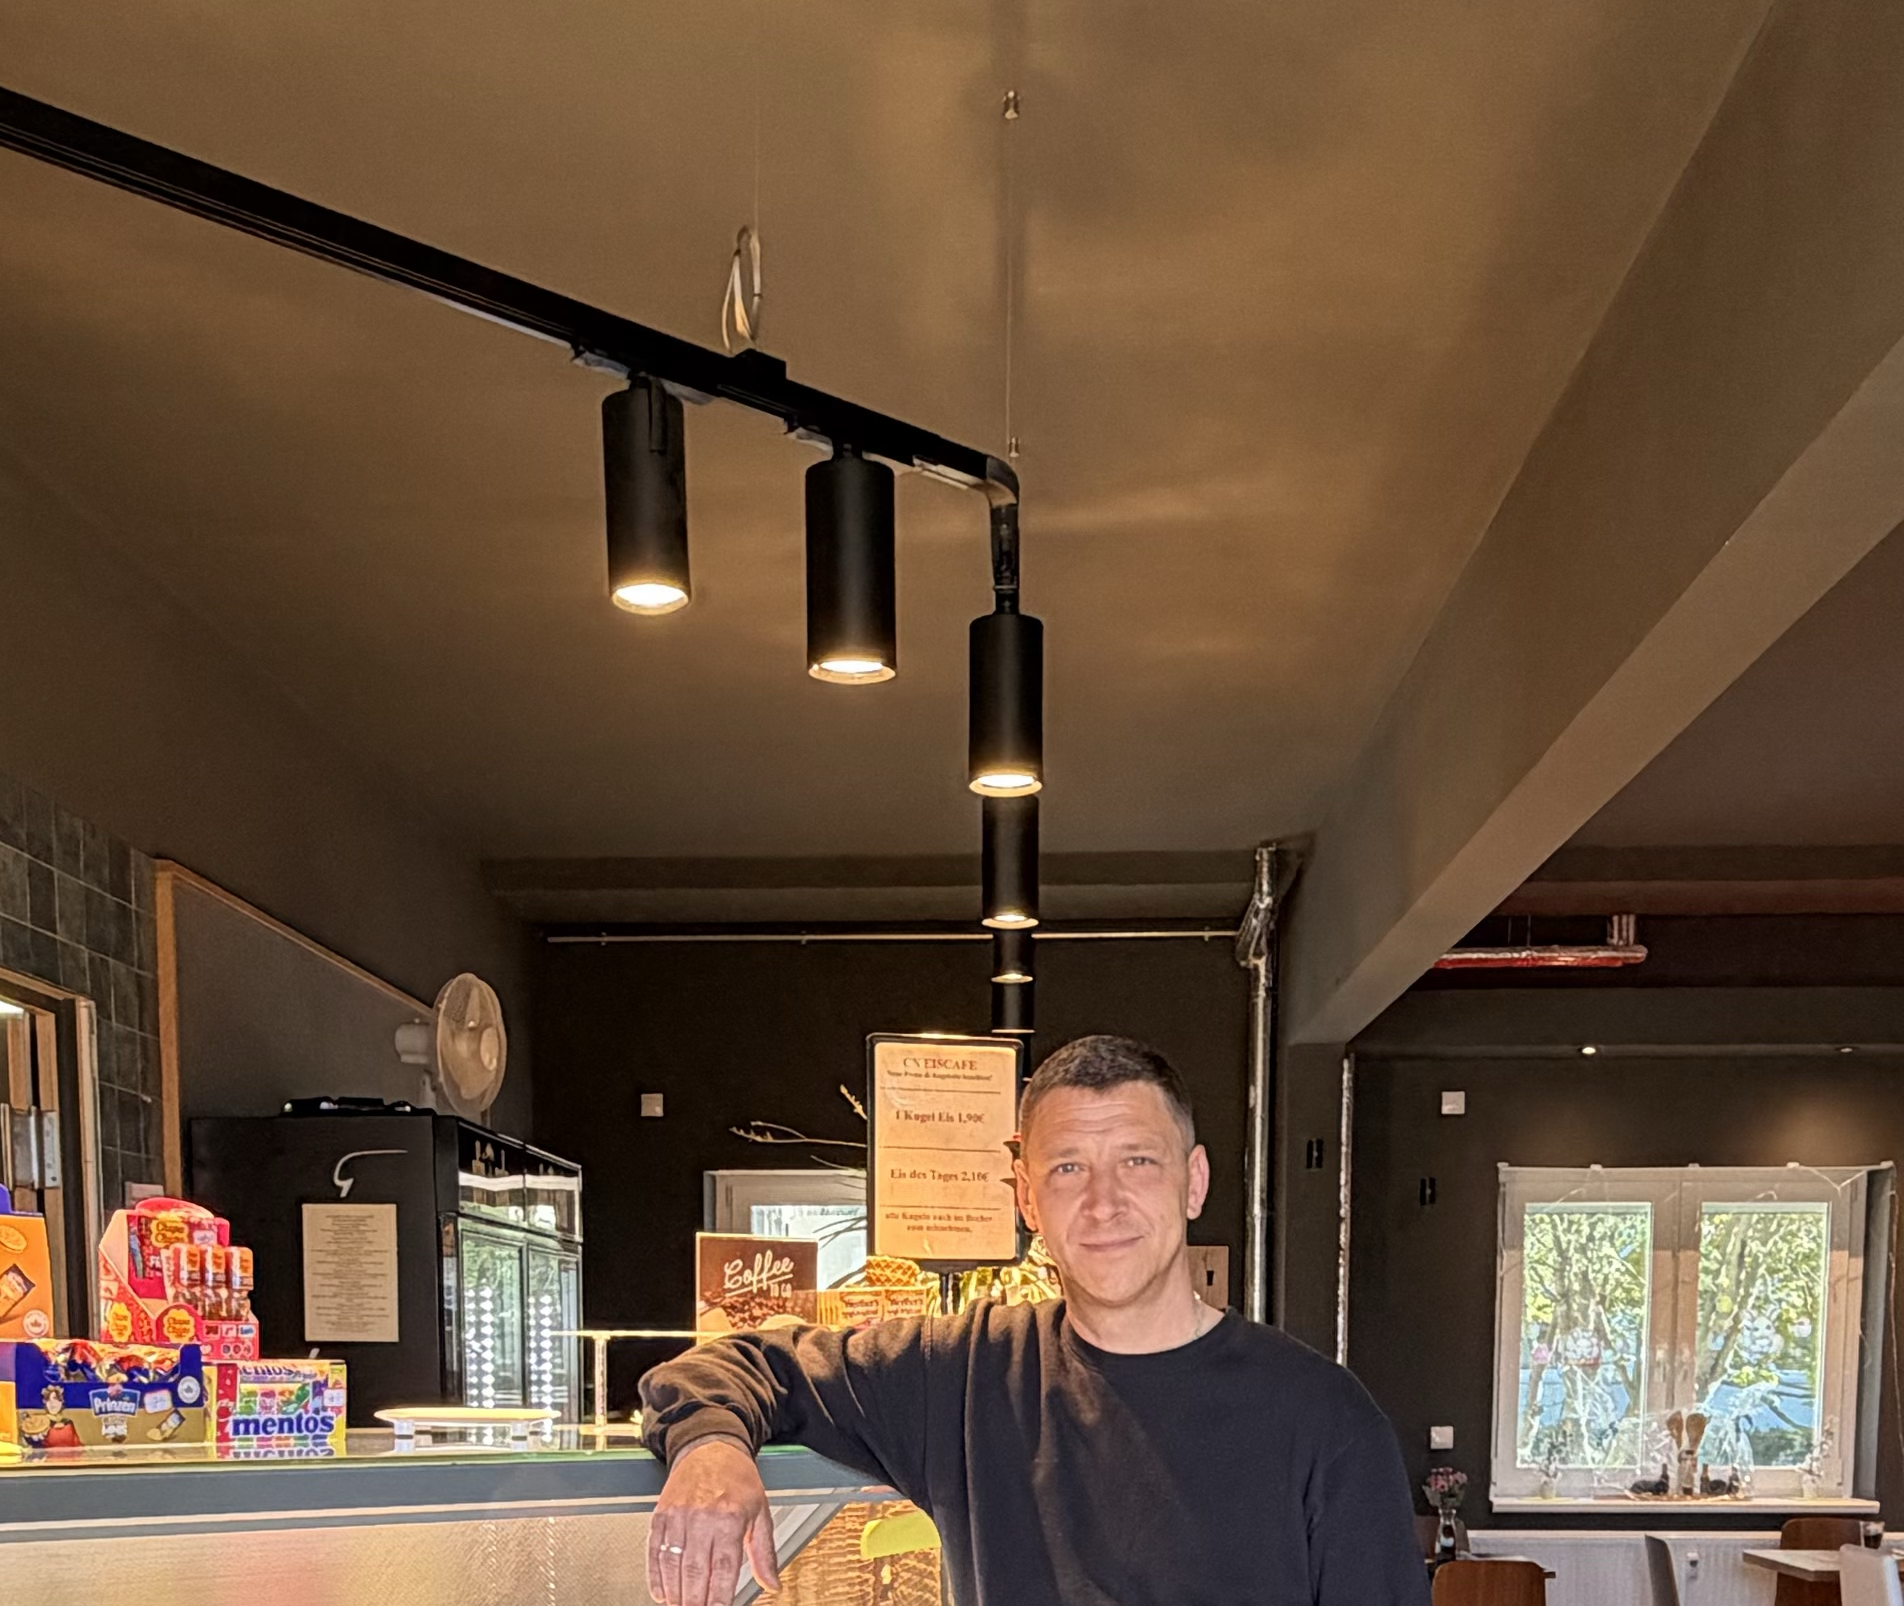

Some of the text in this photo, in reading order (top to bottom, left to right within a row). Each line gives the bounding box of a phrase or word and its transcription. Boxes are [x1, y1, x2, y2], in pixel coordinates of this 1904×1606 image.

[904, 1110, 935, 1124] Kugel
[938, 1112, 954, 1123] Eis
[890, 1168, 906, 1179] Eis
[909, 1169, 927, 1179] des
[930, 1170, 958, 1182] Tages
[723, 1249, 795, 1294] Coffee
[94, 1397, 136, 1414] Prinzen
[231, 1412, 335, 1436] mentos
